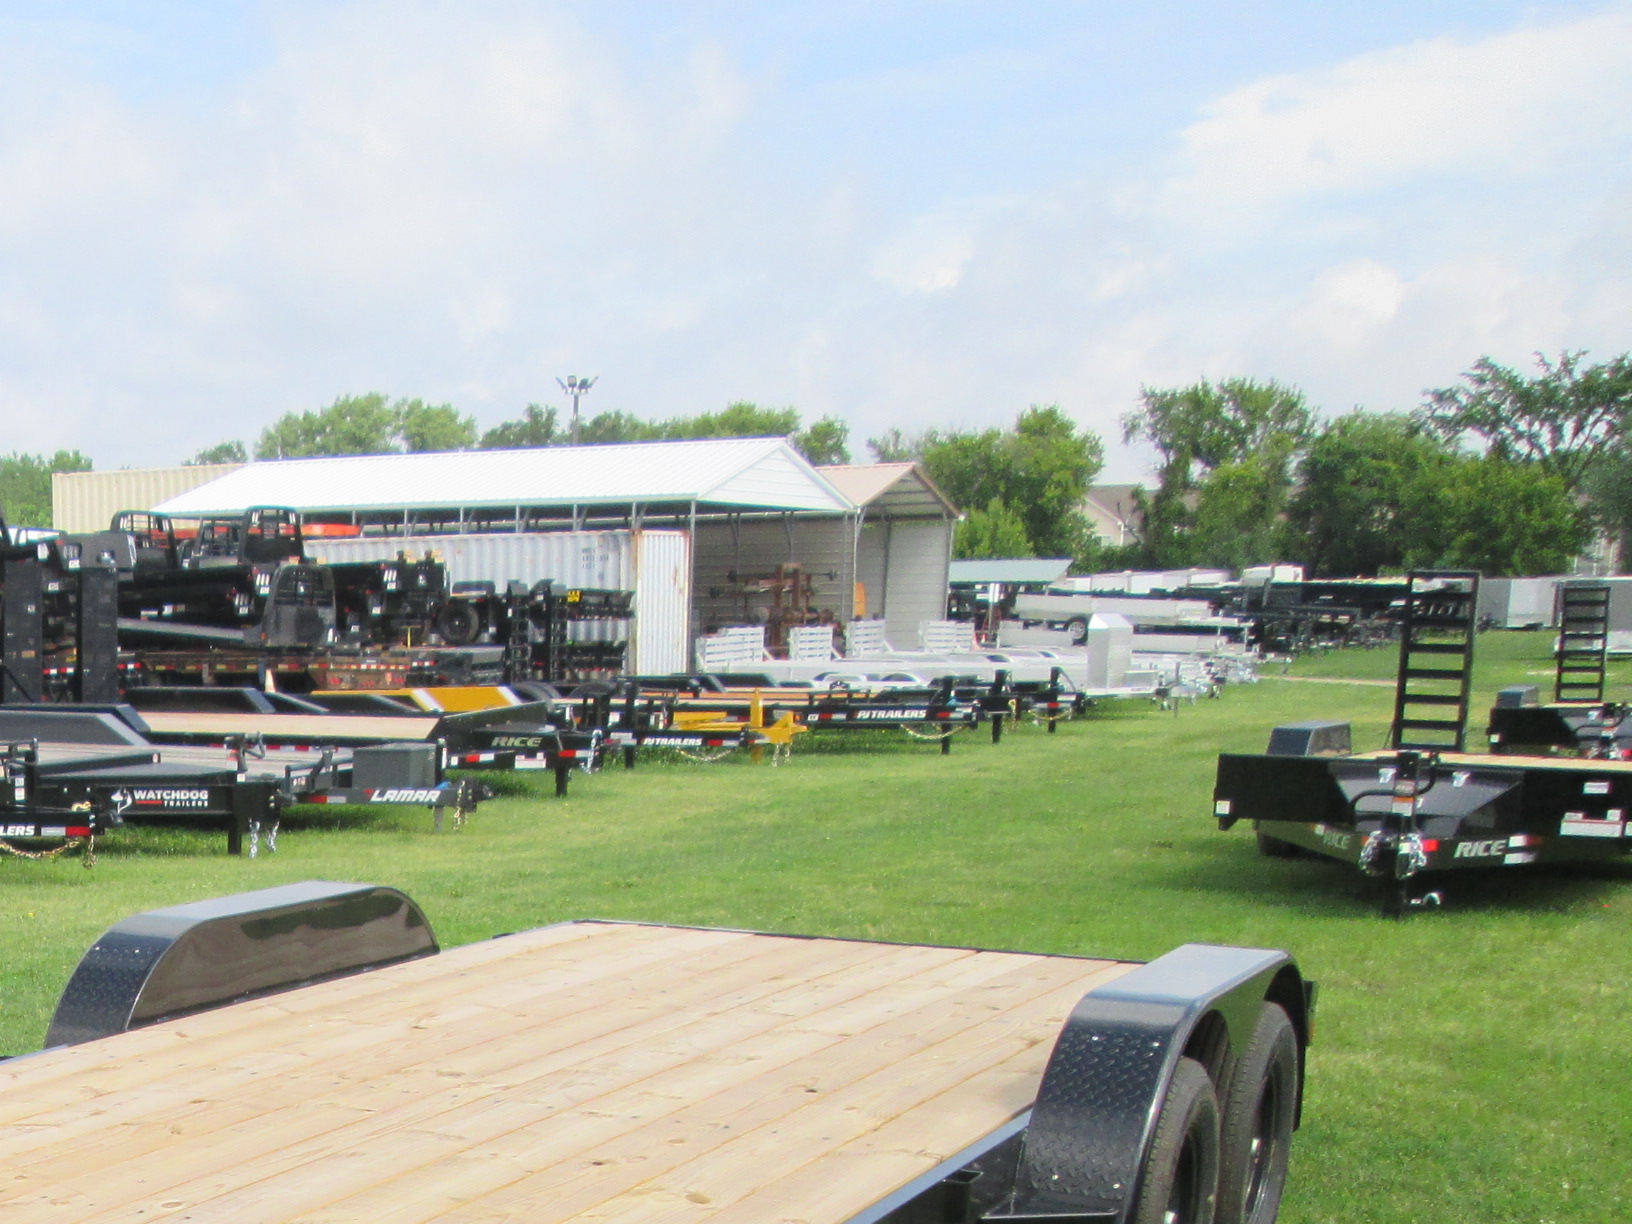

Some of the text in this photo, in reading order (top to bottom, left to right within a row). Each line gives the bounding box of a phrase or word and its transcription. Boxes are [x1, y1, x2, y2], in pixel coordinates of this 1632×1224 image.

[491, 736, 543, 748] RICE
[134, 789, 209, 800] WATCHDOG
[370, 789, 441, 803] LAMAR
[1454, 839, 1508, 858] RICE
